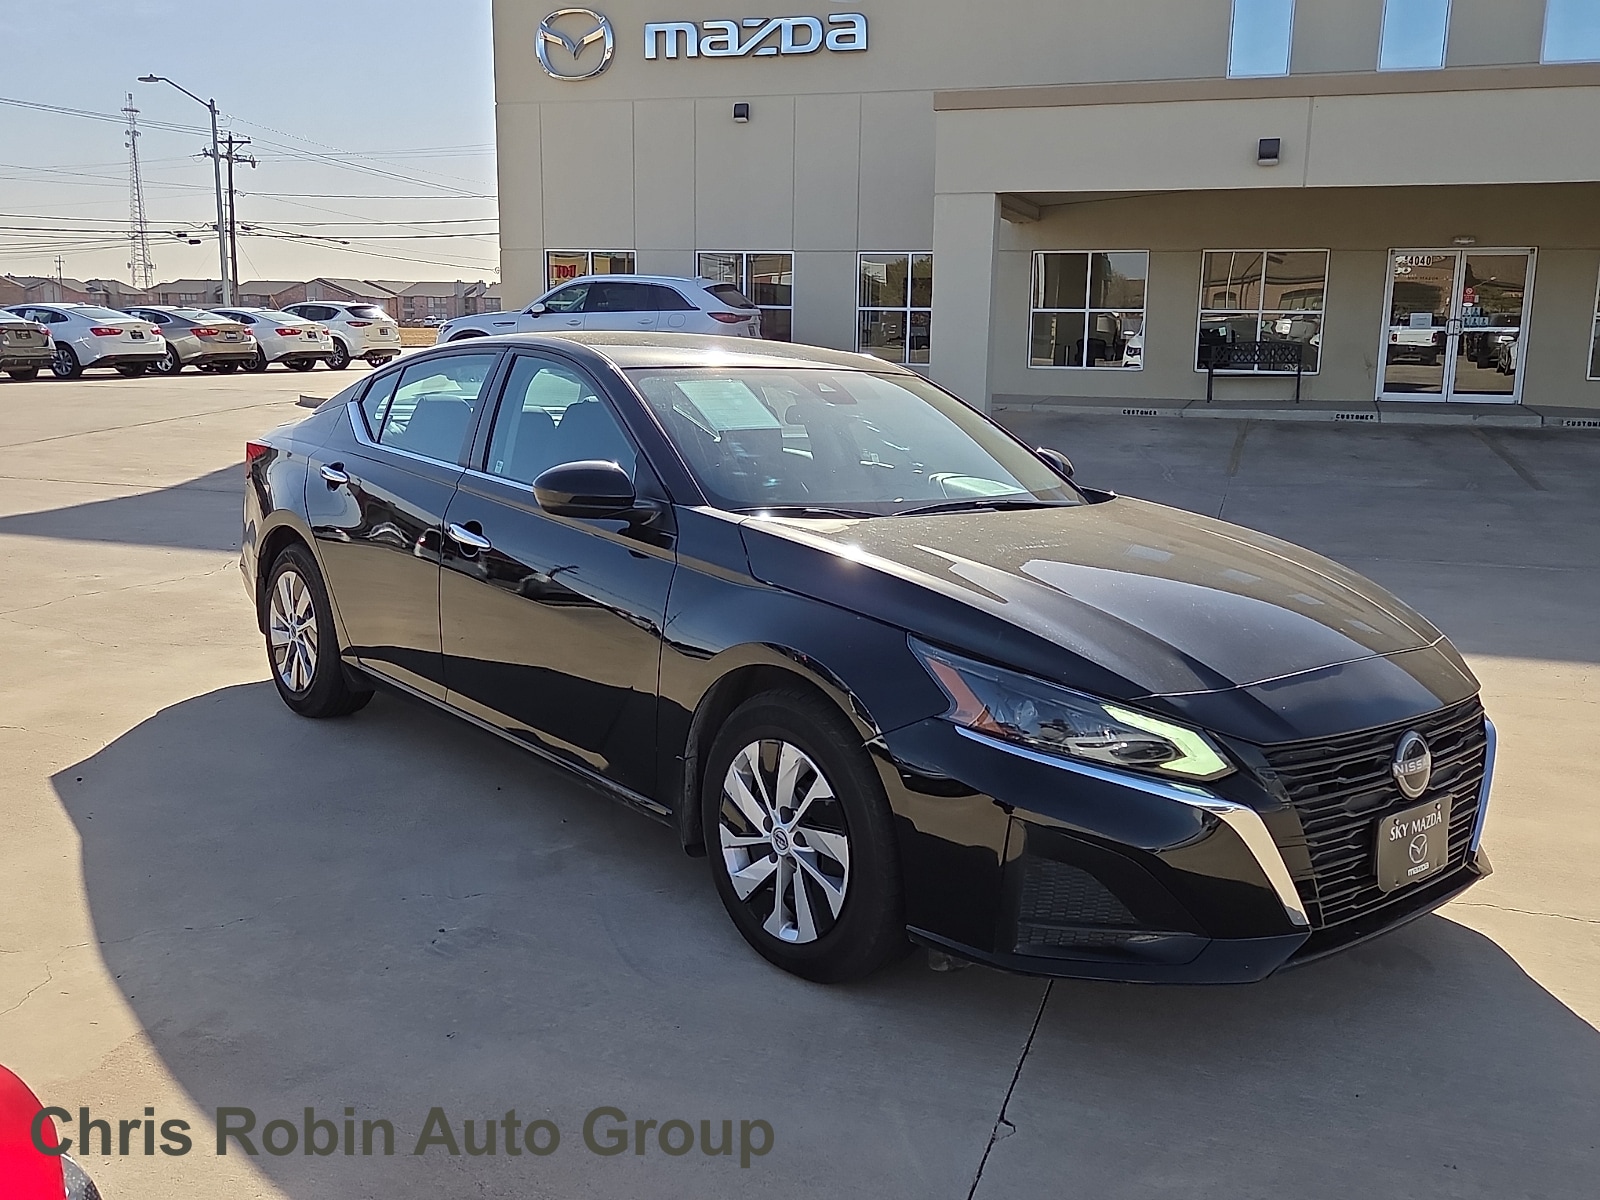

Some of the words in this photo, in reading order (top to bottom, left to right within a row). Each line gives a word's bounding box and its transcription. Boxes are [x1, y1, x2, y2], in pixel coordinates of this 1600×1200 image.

[1408, 255, 1432, 265] 4040
[1389, 822, 1409, 841] SKY
[1411, 811, 1442, 835] MAZDA
